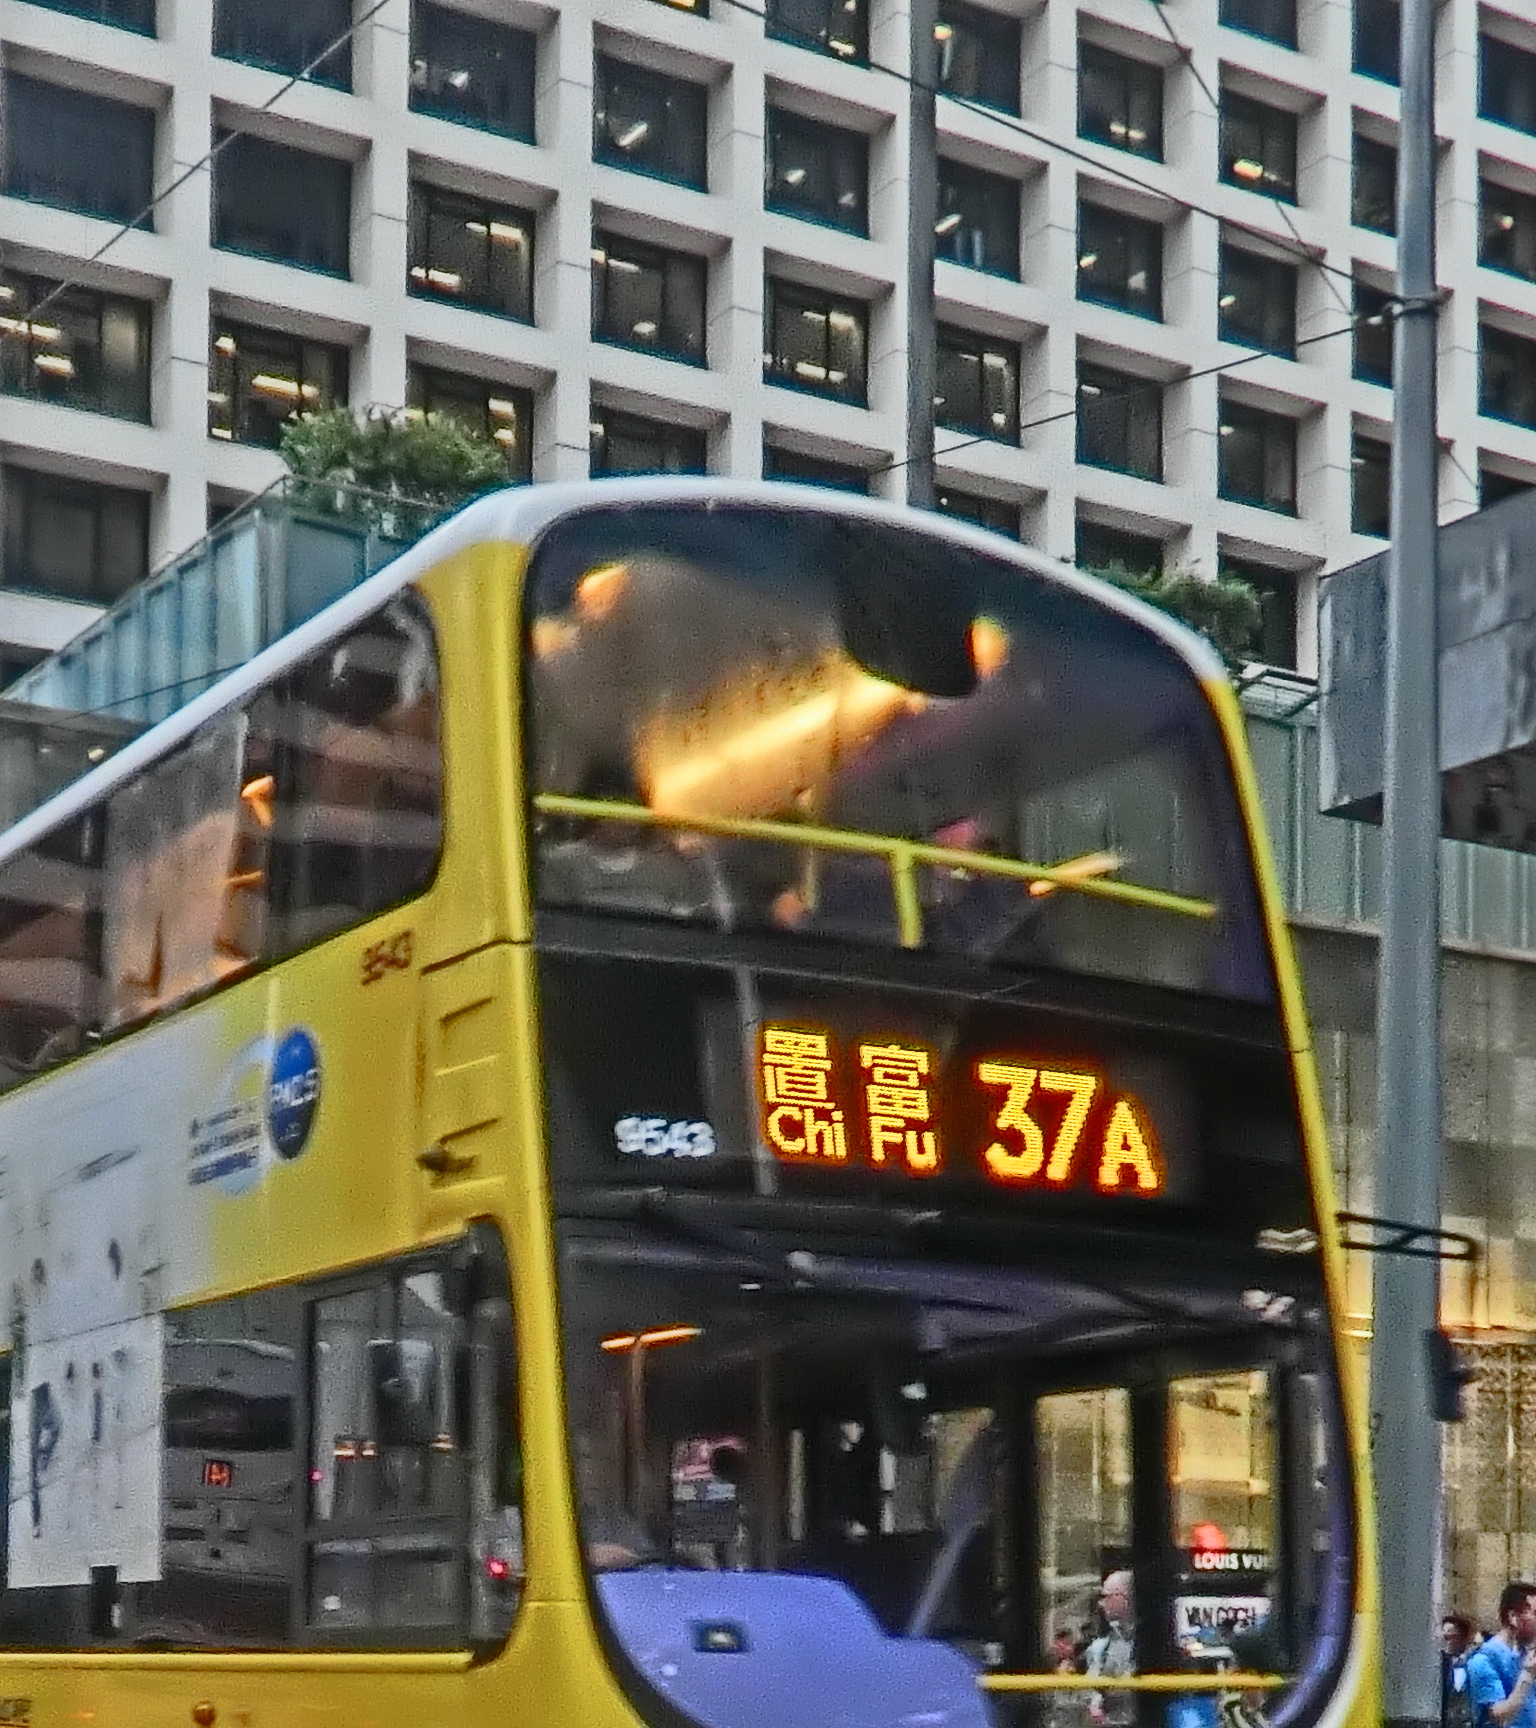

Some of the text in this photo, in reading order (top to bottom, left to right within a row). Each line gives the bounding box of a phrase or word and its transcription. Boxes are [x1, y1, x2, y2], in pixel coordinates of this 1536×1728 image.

[763, 1026, 934, 1122] 置富
[767, 1104, 937, 1170] Chi Fu
[977, 1061, 1160, 1190] 37A
[1193, 1552, 1239, 1570] LOUIS
